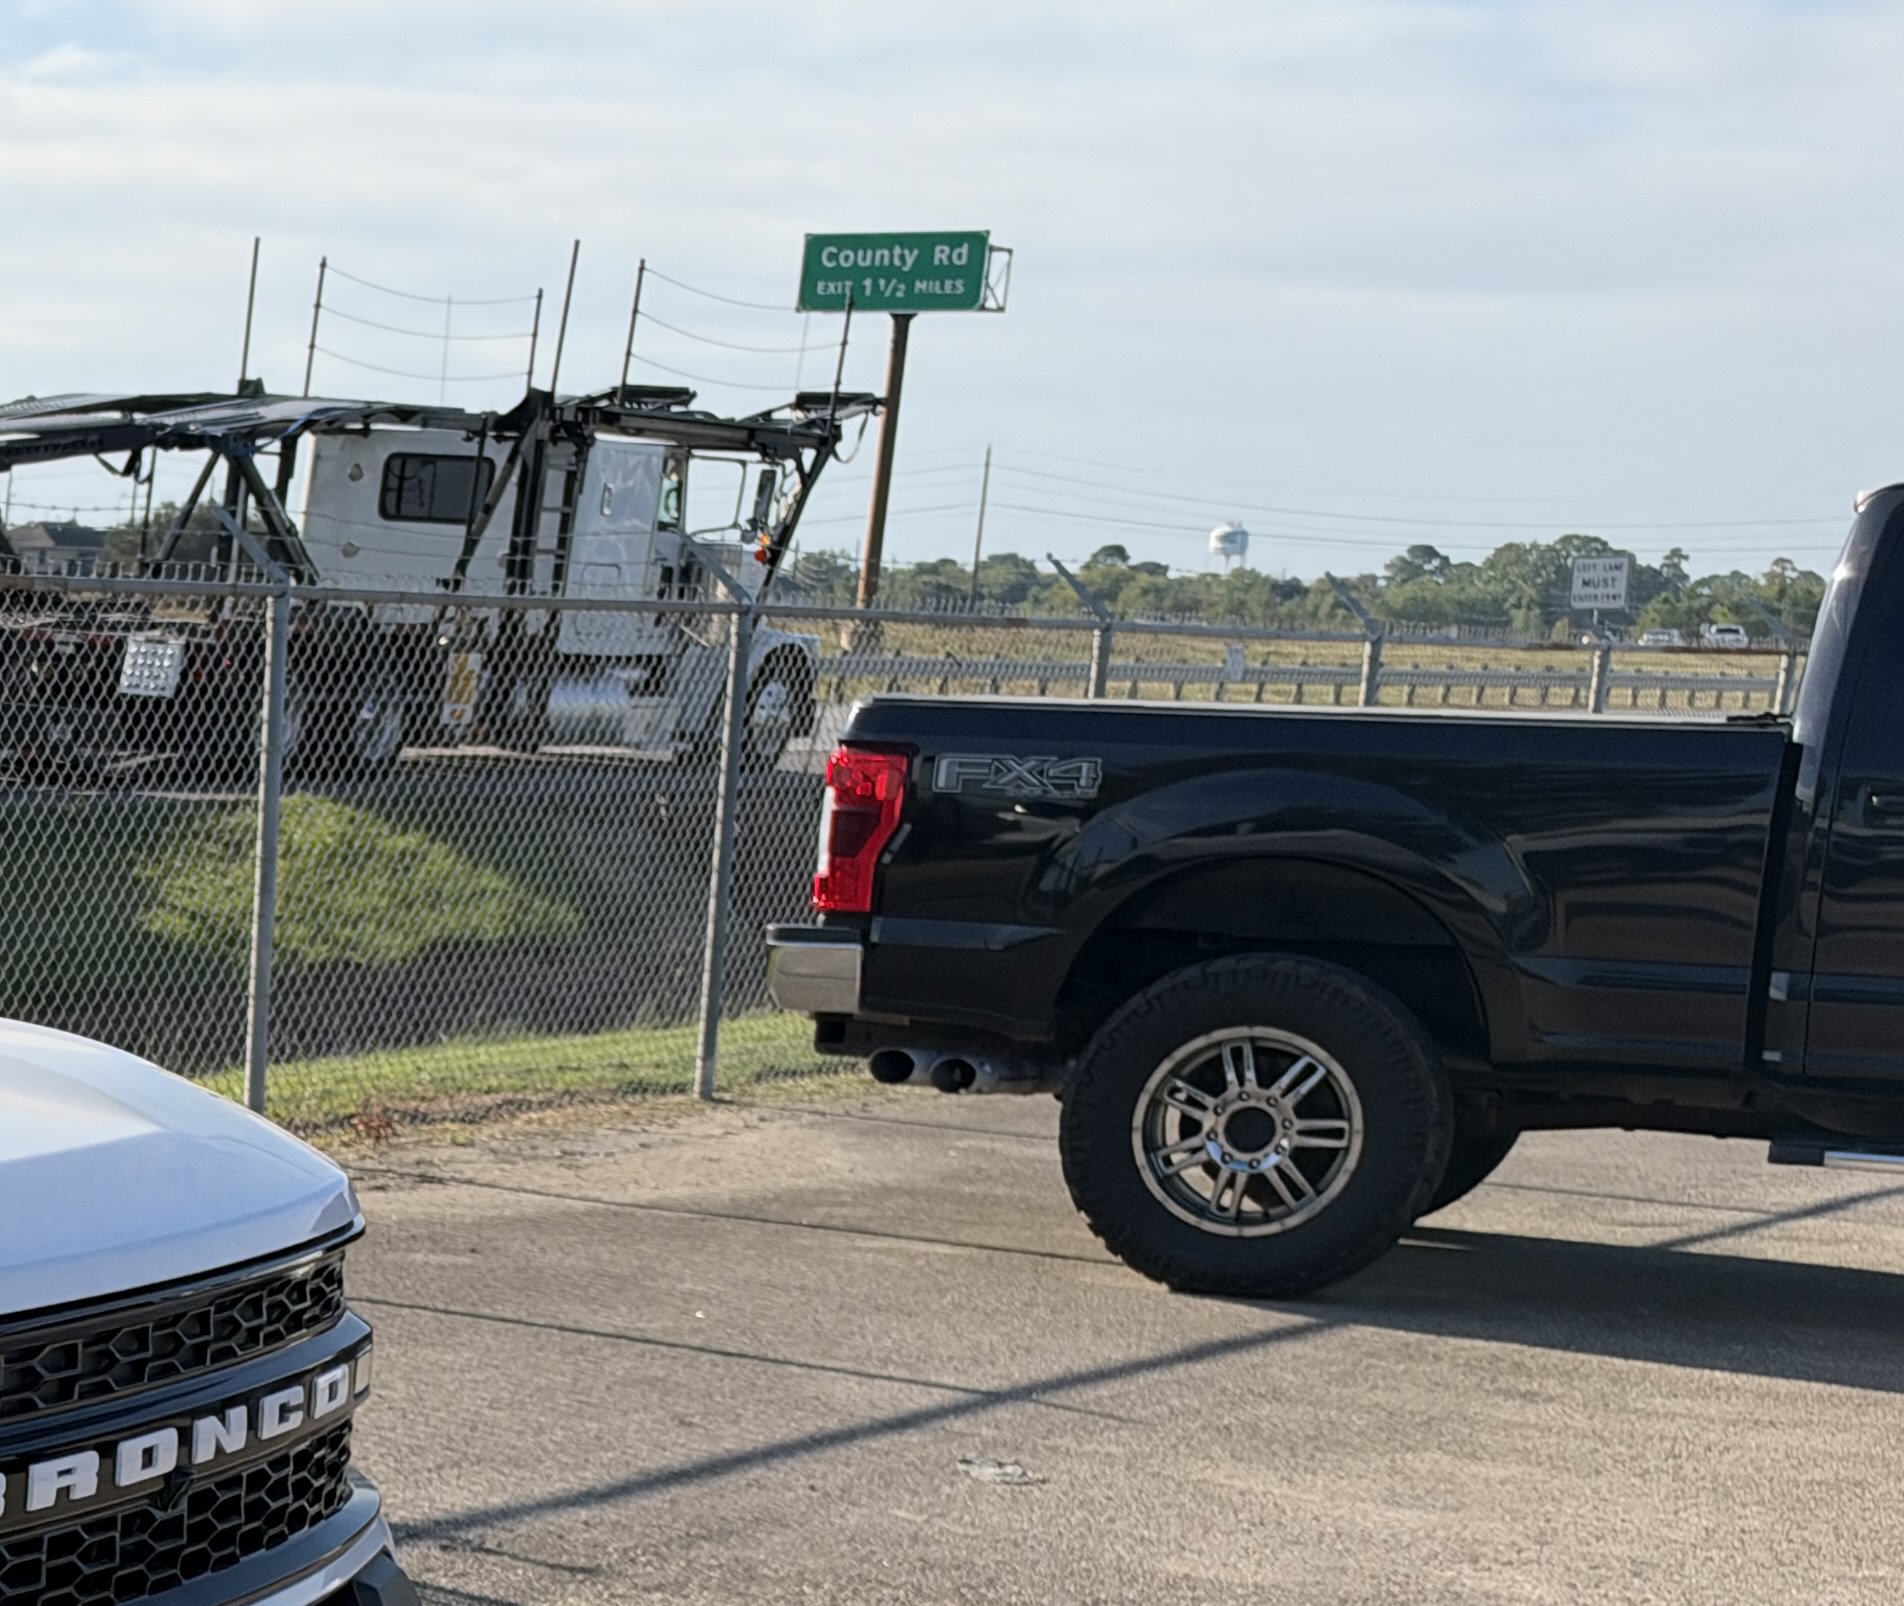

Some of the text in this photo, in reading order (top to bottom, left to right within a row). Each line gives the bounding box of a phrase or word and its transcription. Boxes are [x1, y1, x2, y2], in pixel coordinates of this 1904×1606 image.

[820, 242, 970, 272] County Rd
[816, 280, 854, 296] EXIT
[913, 278, 966, 295] MILES
[1581, 576, 1617, 589] MUST
[931, 752, 1103, 794] FX4
